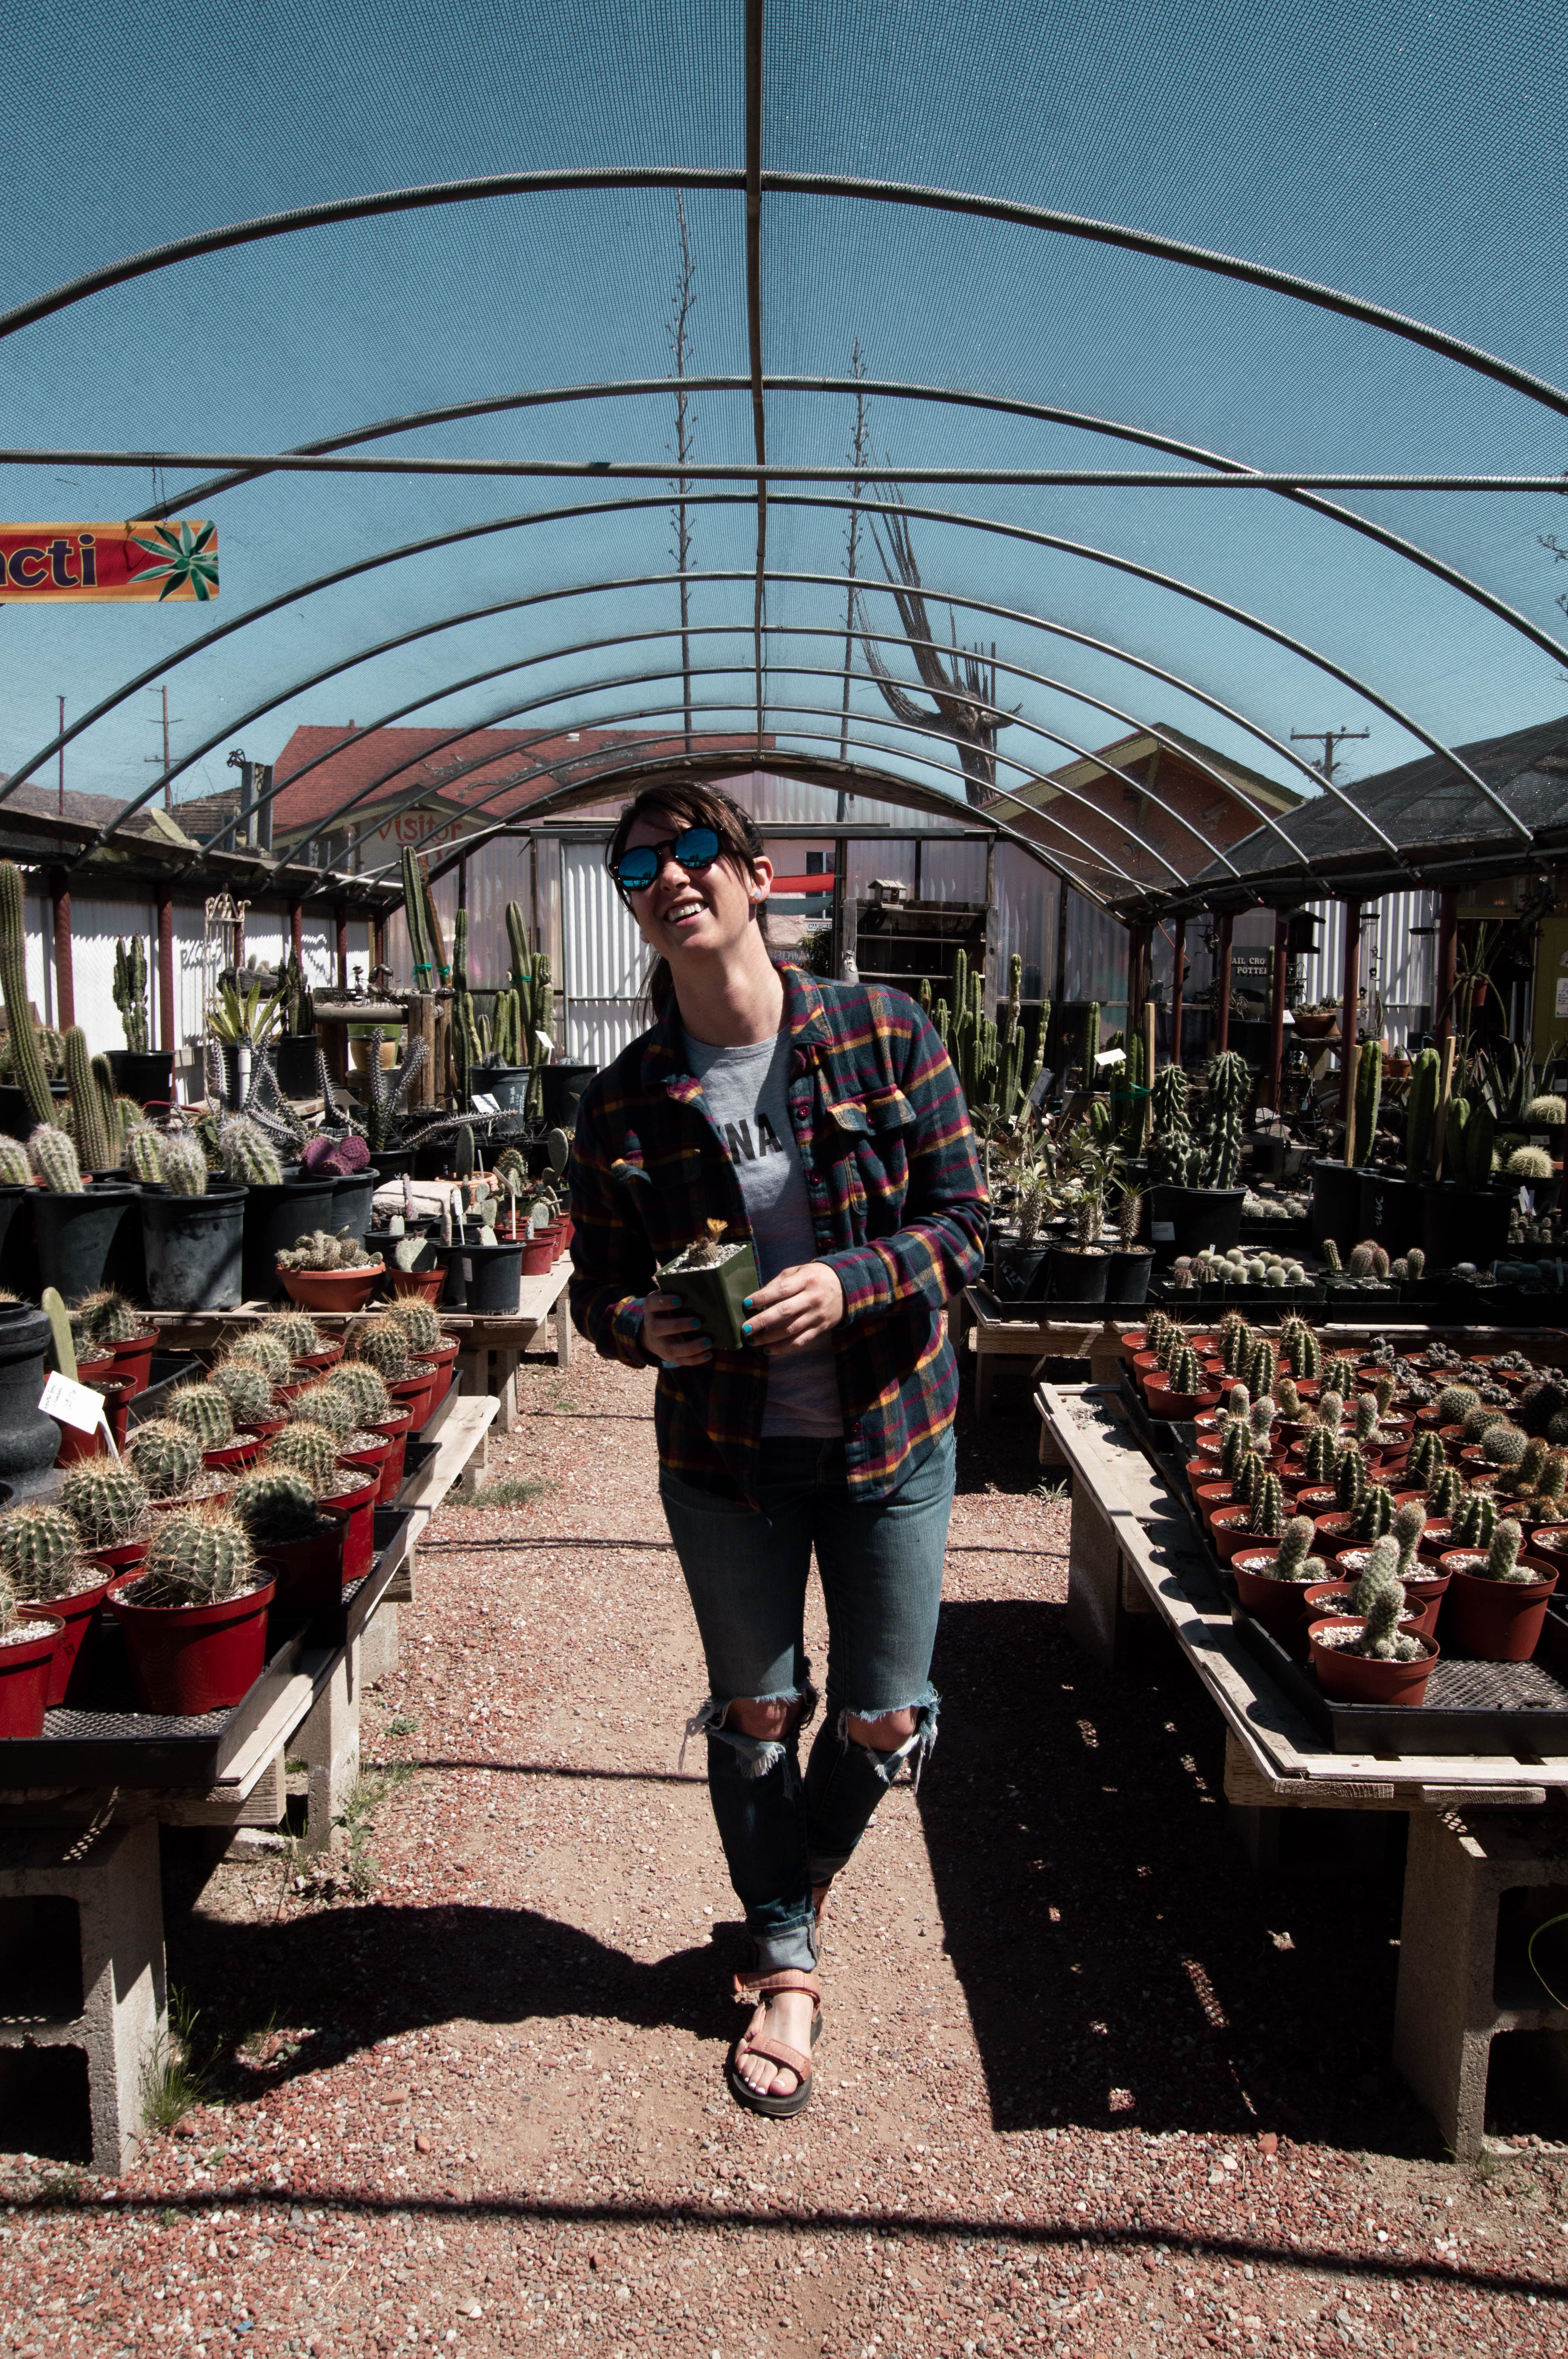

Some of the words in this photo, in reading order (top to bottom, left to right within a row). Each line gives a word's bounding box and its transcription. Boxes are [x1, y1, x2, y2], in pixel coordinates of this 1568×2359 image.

[0, 533, 97, 587] cti
[371, 814, 463, 841] Visitor
[717, 1113, 783, 1165] NA
